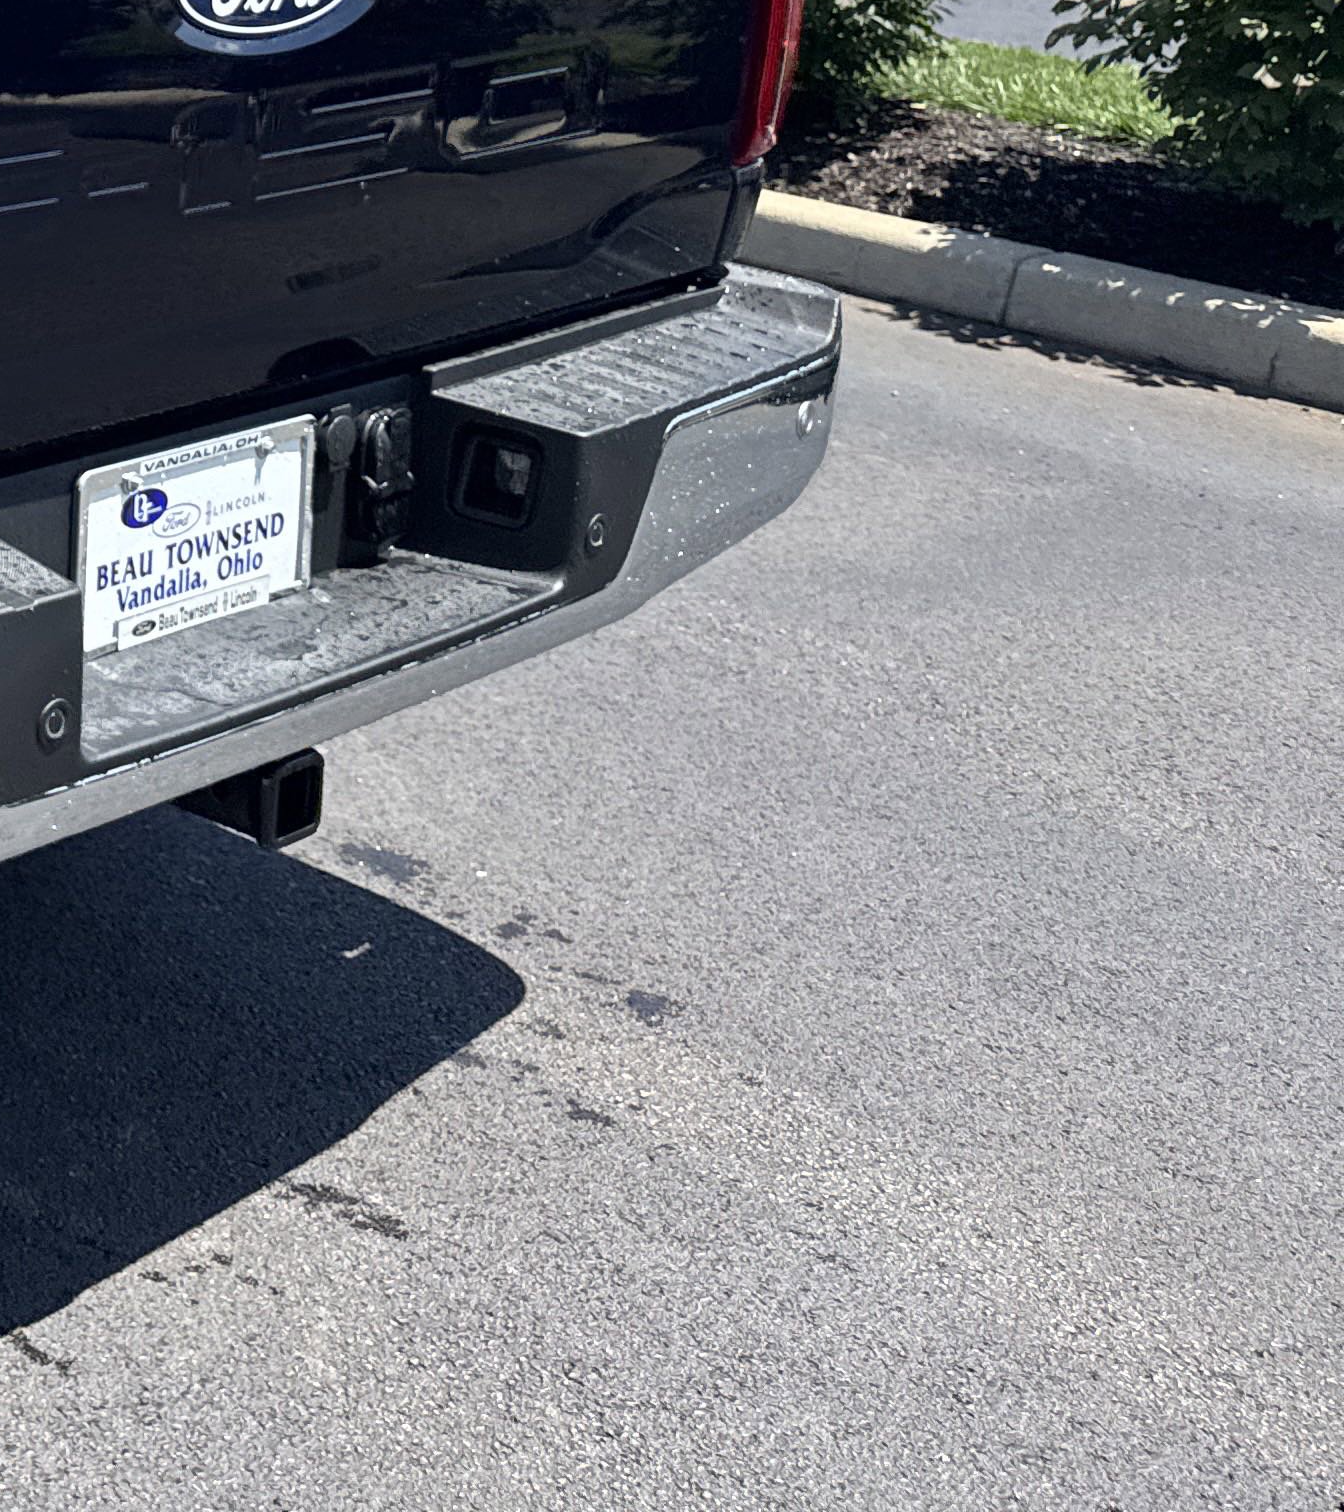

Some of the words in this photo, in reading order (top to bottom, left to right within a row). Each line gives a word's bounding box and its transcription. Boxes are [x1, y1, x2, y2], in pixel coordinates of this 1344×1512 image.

[235, 434, 258, 449] OH
[213, 492, 265, 516] LINCOLN
[162, 510, 191, 532] Ford
[97, 549, 153, 593] BEAU
[165, 512, 284, 569] TOWNSEND
[217, 549, 263, 580] Ohio
